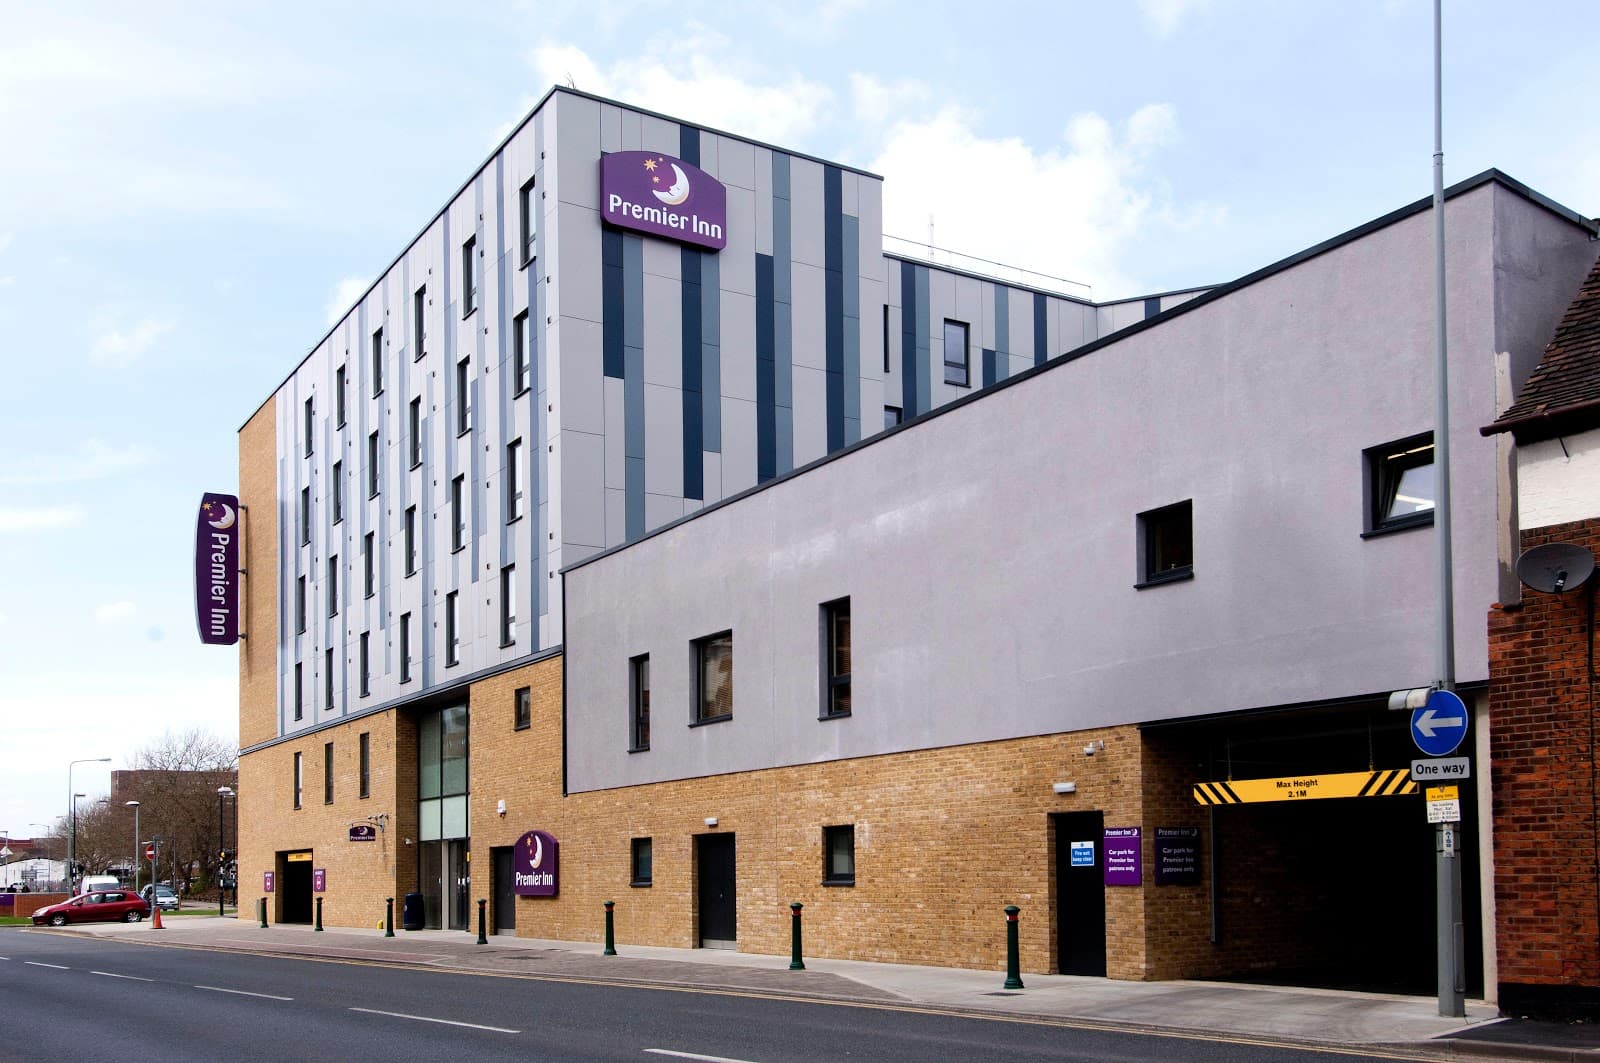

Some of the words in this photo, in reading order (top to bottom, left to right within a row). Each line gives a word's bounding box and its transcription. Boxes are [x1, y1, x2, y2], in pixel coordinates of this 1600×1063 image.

[609, 193, 689, 230] Premier
[692, 214, 722, 240] Inn
[211, 532, 230, 605] Premier
[211, 608, 230, 636] Inn
[1415, 764, 1438, 775] One
[1442, 764, 1465, 775] way
[1293, 779, 1318, 788] Height
[1288, 790, 1307, 798] 2.1M
[1158, 828, 1180, 836] Premier
[1125, 865, 1135, 873] only
[515, 871, 542, 887] Premier
[542, 870, 553, 886] Inn
